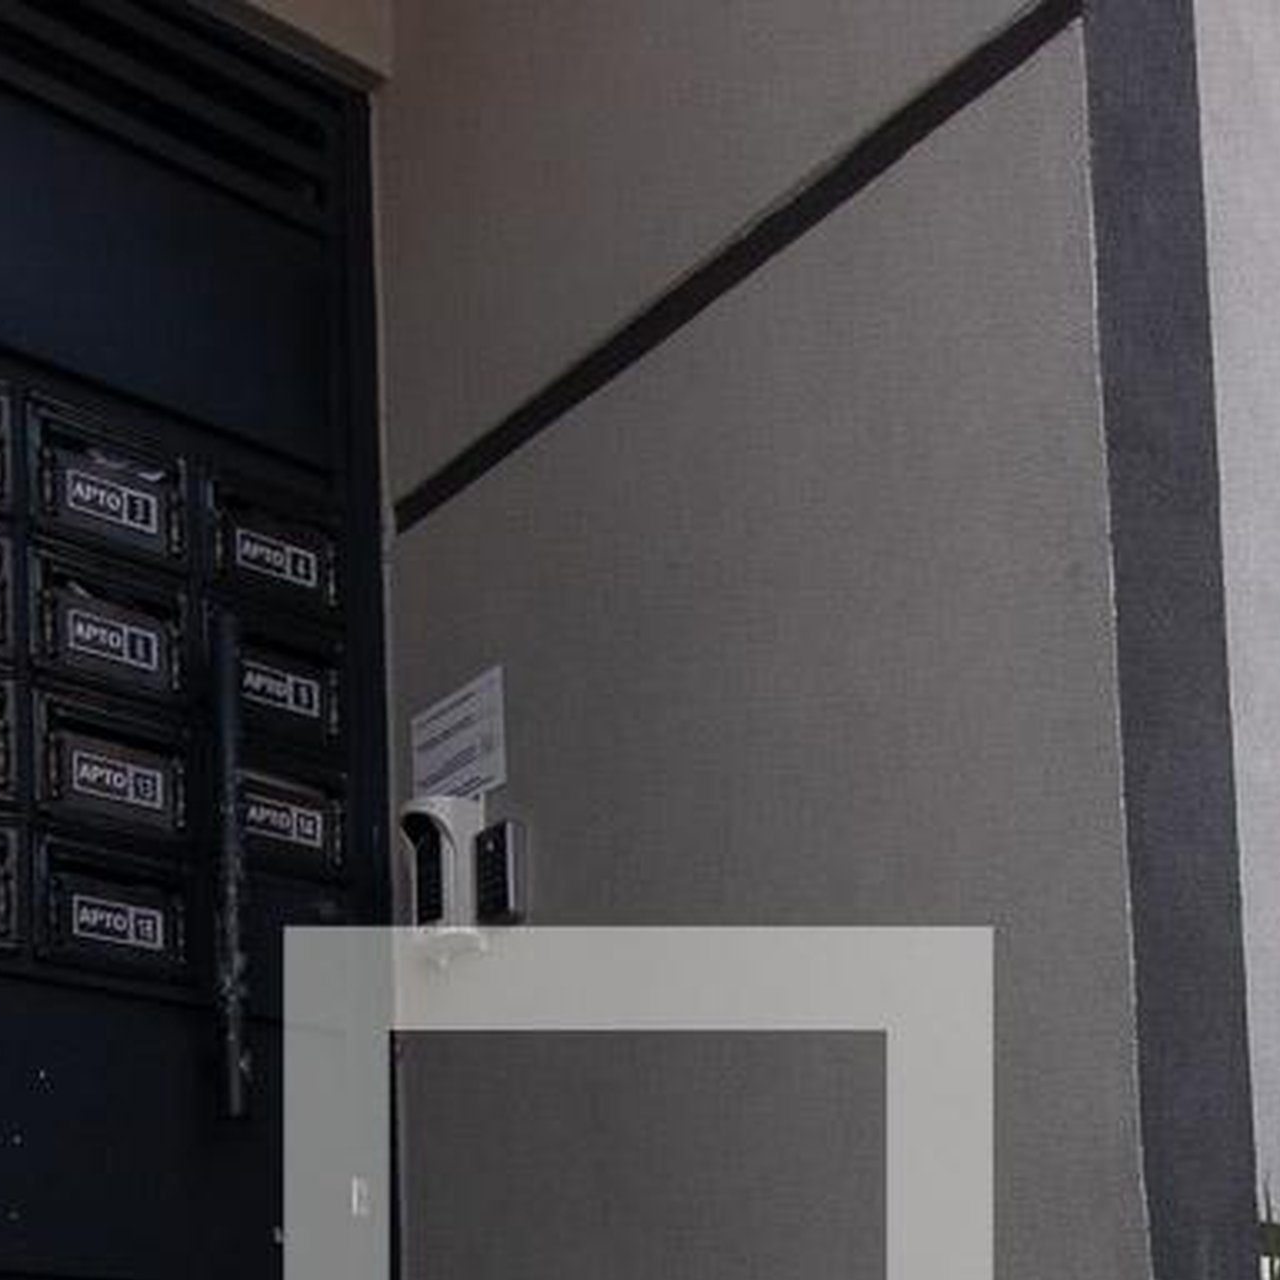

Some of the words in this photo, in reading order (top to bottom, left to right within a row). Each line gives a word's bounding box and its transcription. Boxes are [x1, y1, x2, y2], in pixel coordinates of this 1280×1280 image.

[71, 480, 122, 511] APTO
[131, 497, 146, 521] 3
[241, 544, 286, 569] APTO
[75, 619, 123, 649] APTO
[78, 761, 127, 790] APTO
[134, 774, 156, 798] 13
[246, 804, 292, 831] APTO
[78, 904, 128, 934] APTO
